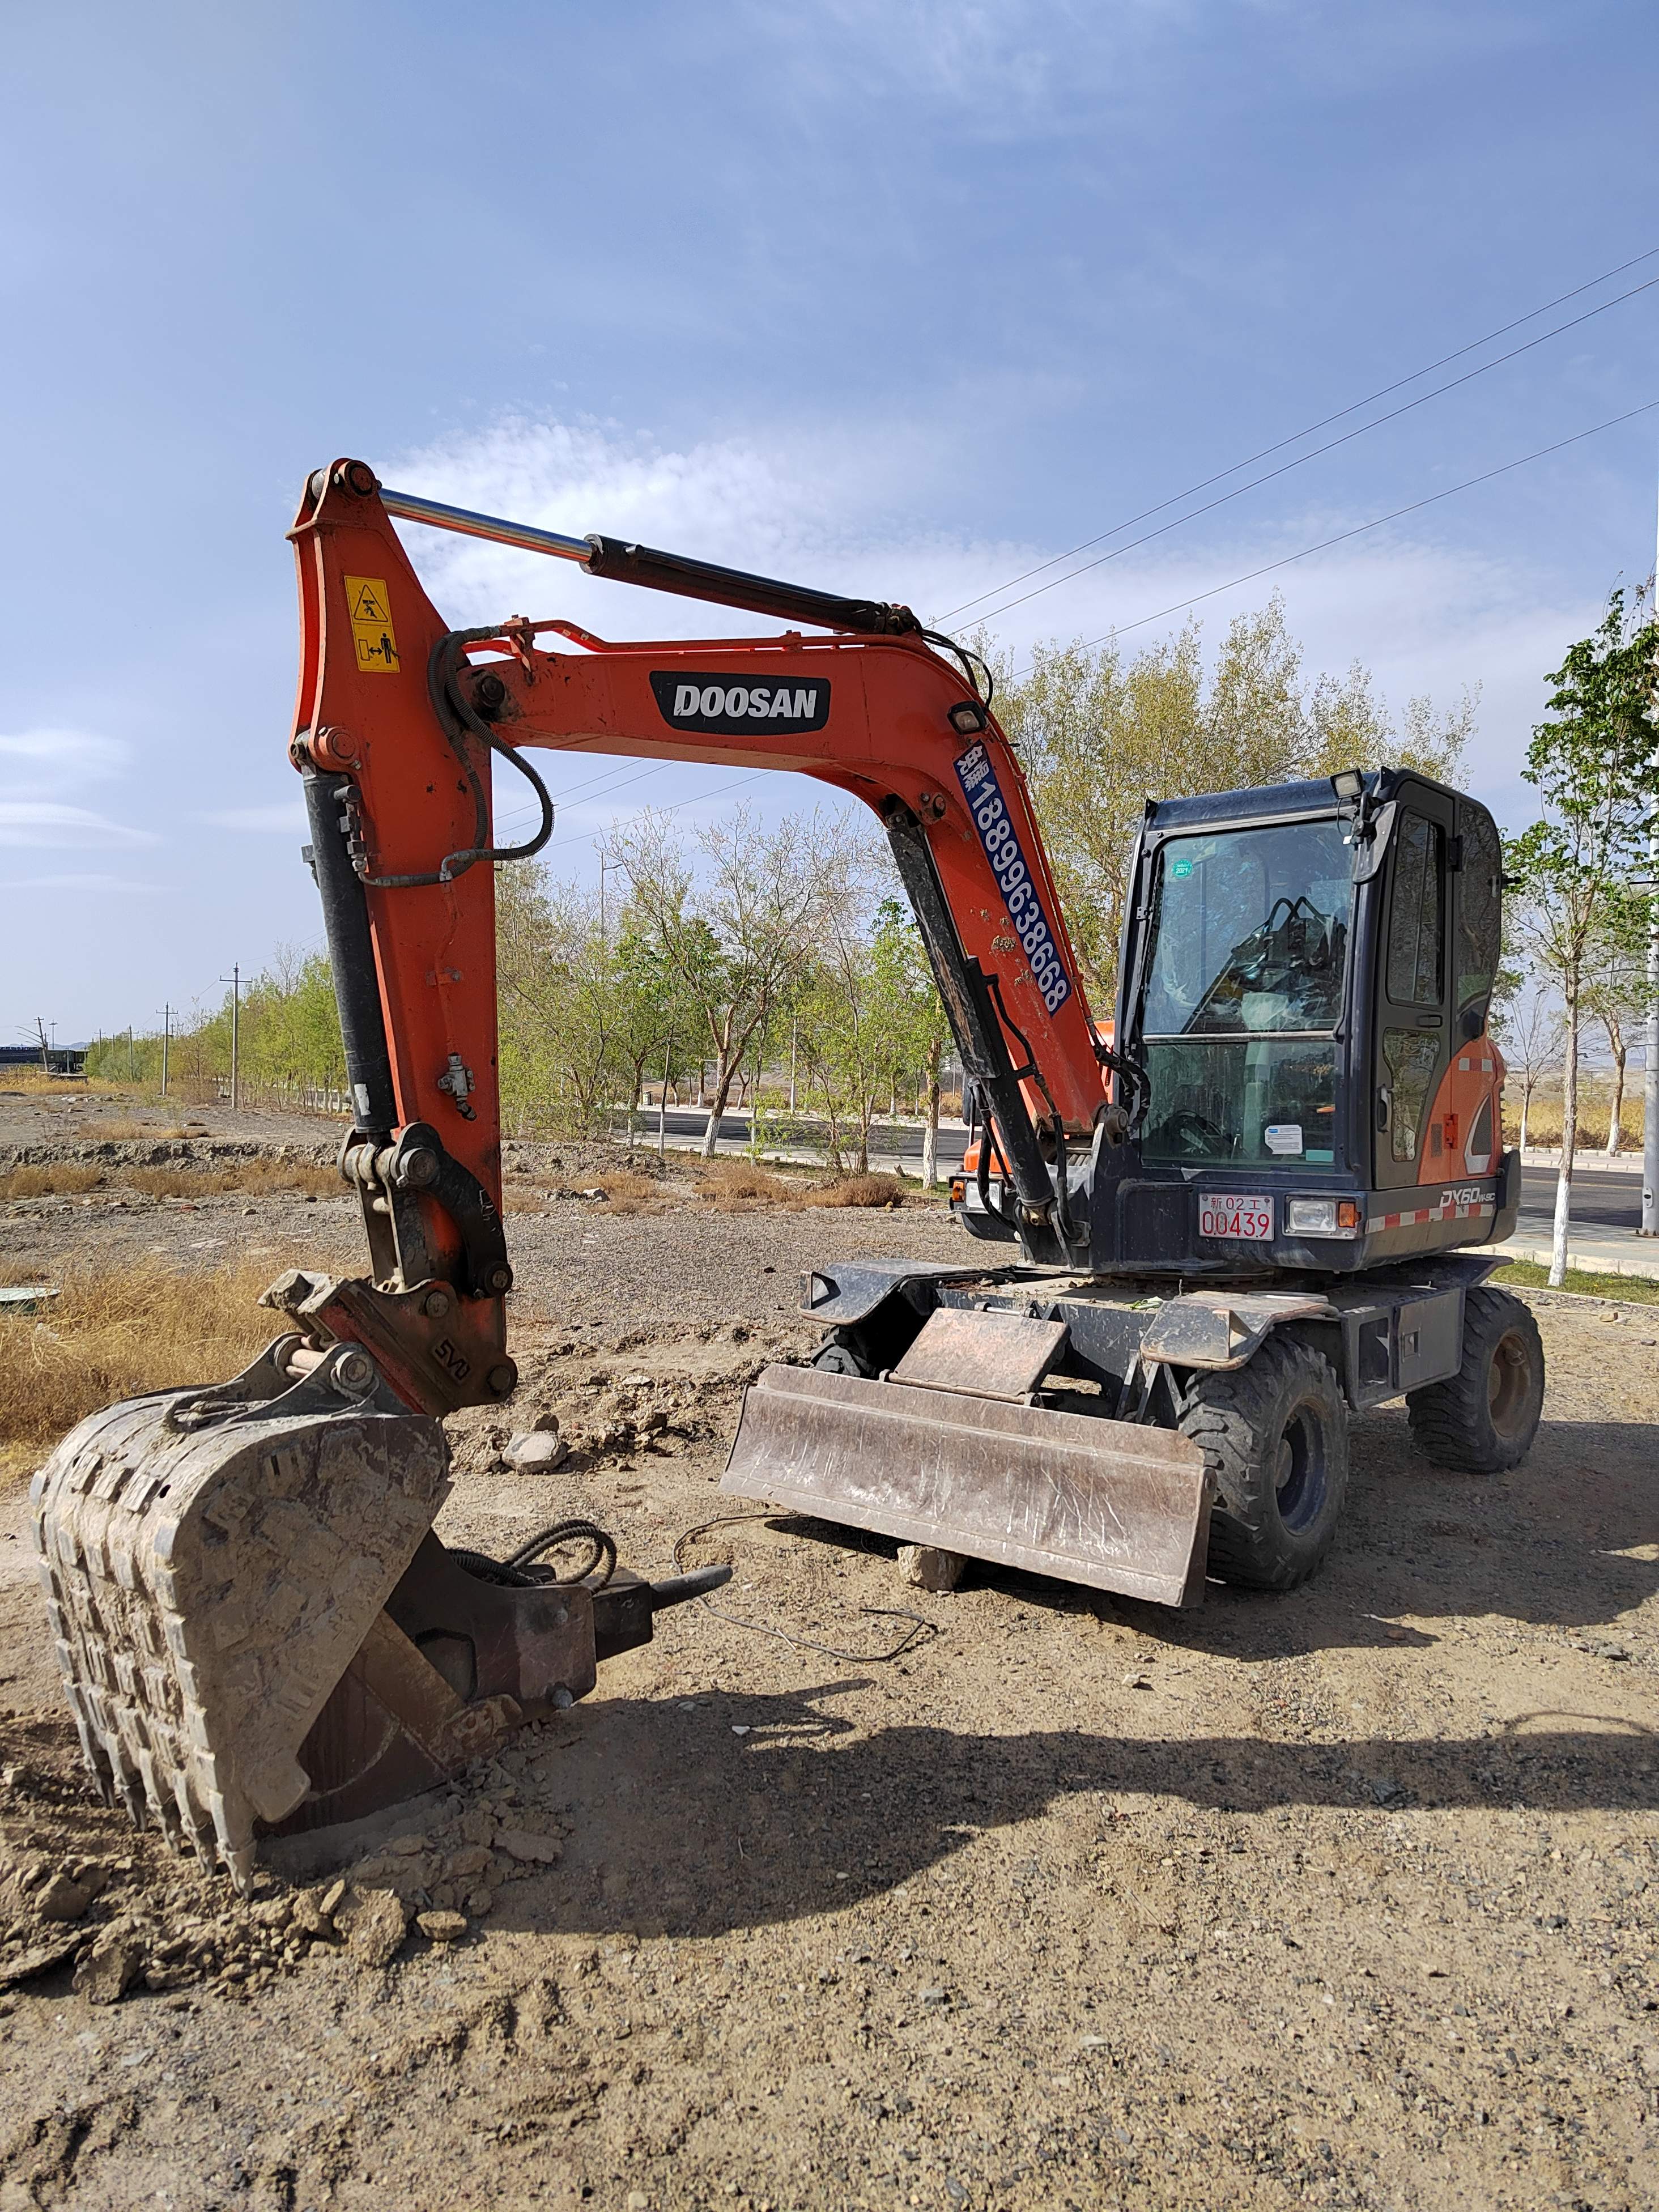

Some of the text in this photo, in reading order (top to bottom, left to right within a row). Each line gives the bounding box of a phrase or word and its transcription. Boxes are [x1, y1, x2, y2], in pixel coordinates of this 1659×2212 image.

[674, 685, 817, 718] DOOSAN
[972, 782, 1067, 1011] 18899638668
[1202, 1211, 1270, 1237] 00439
